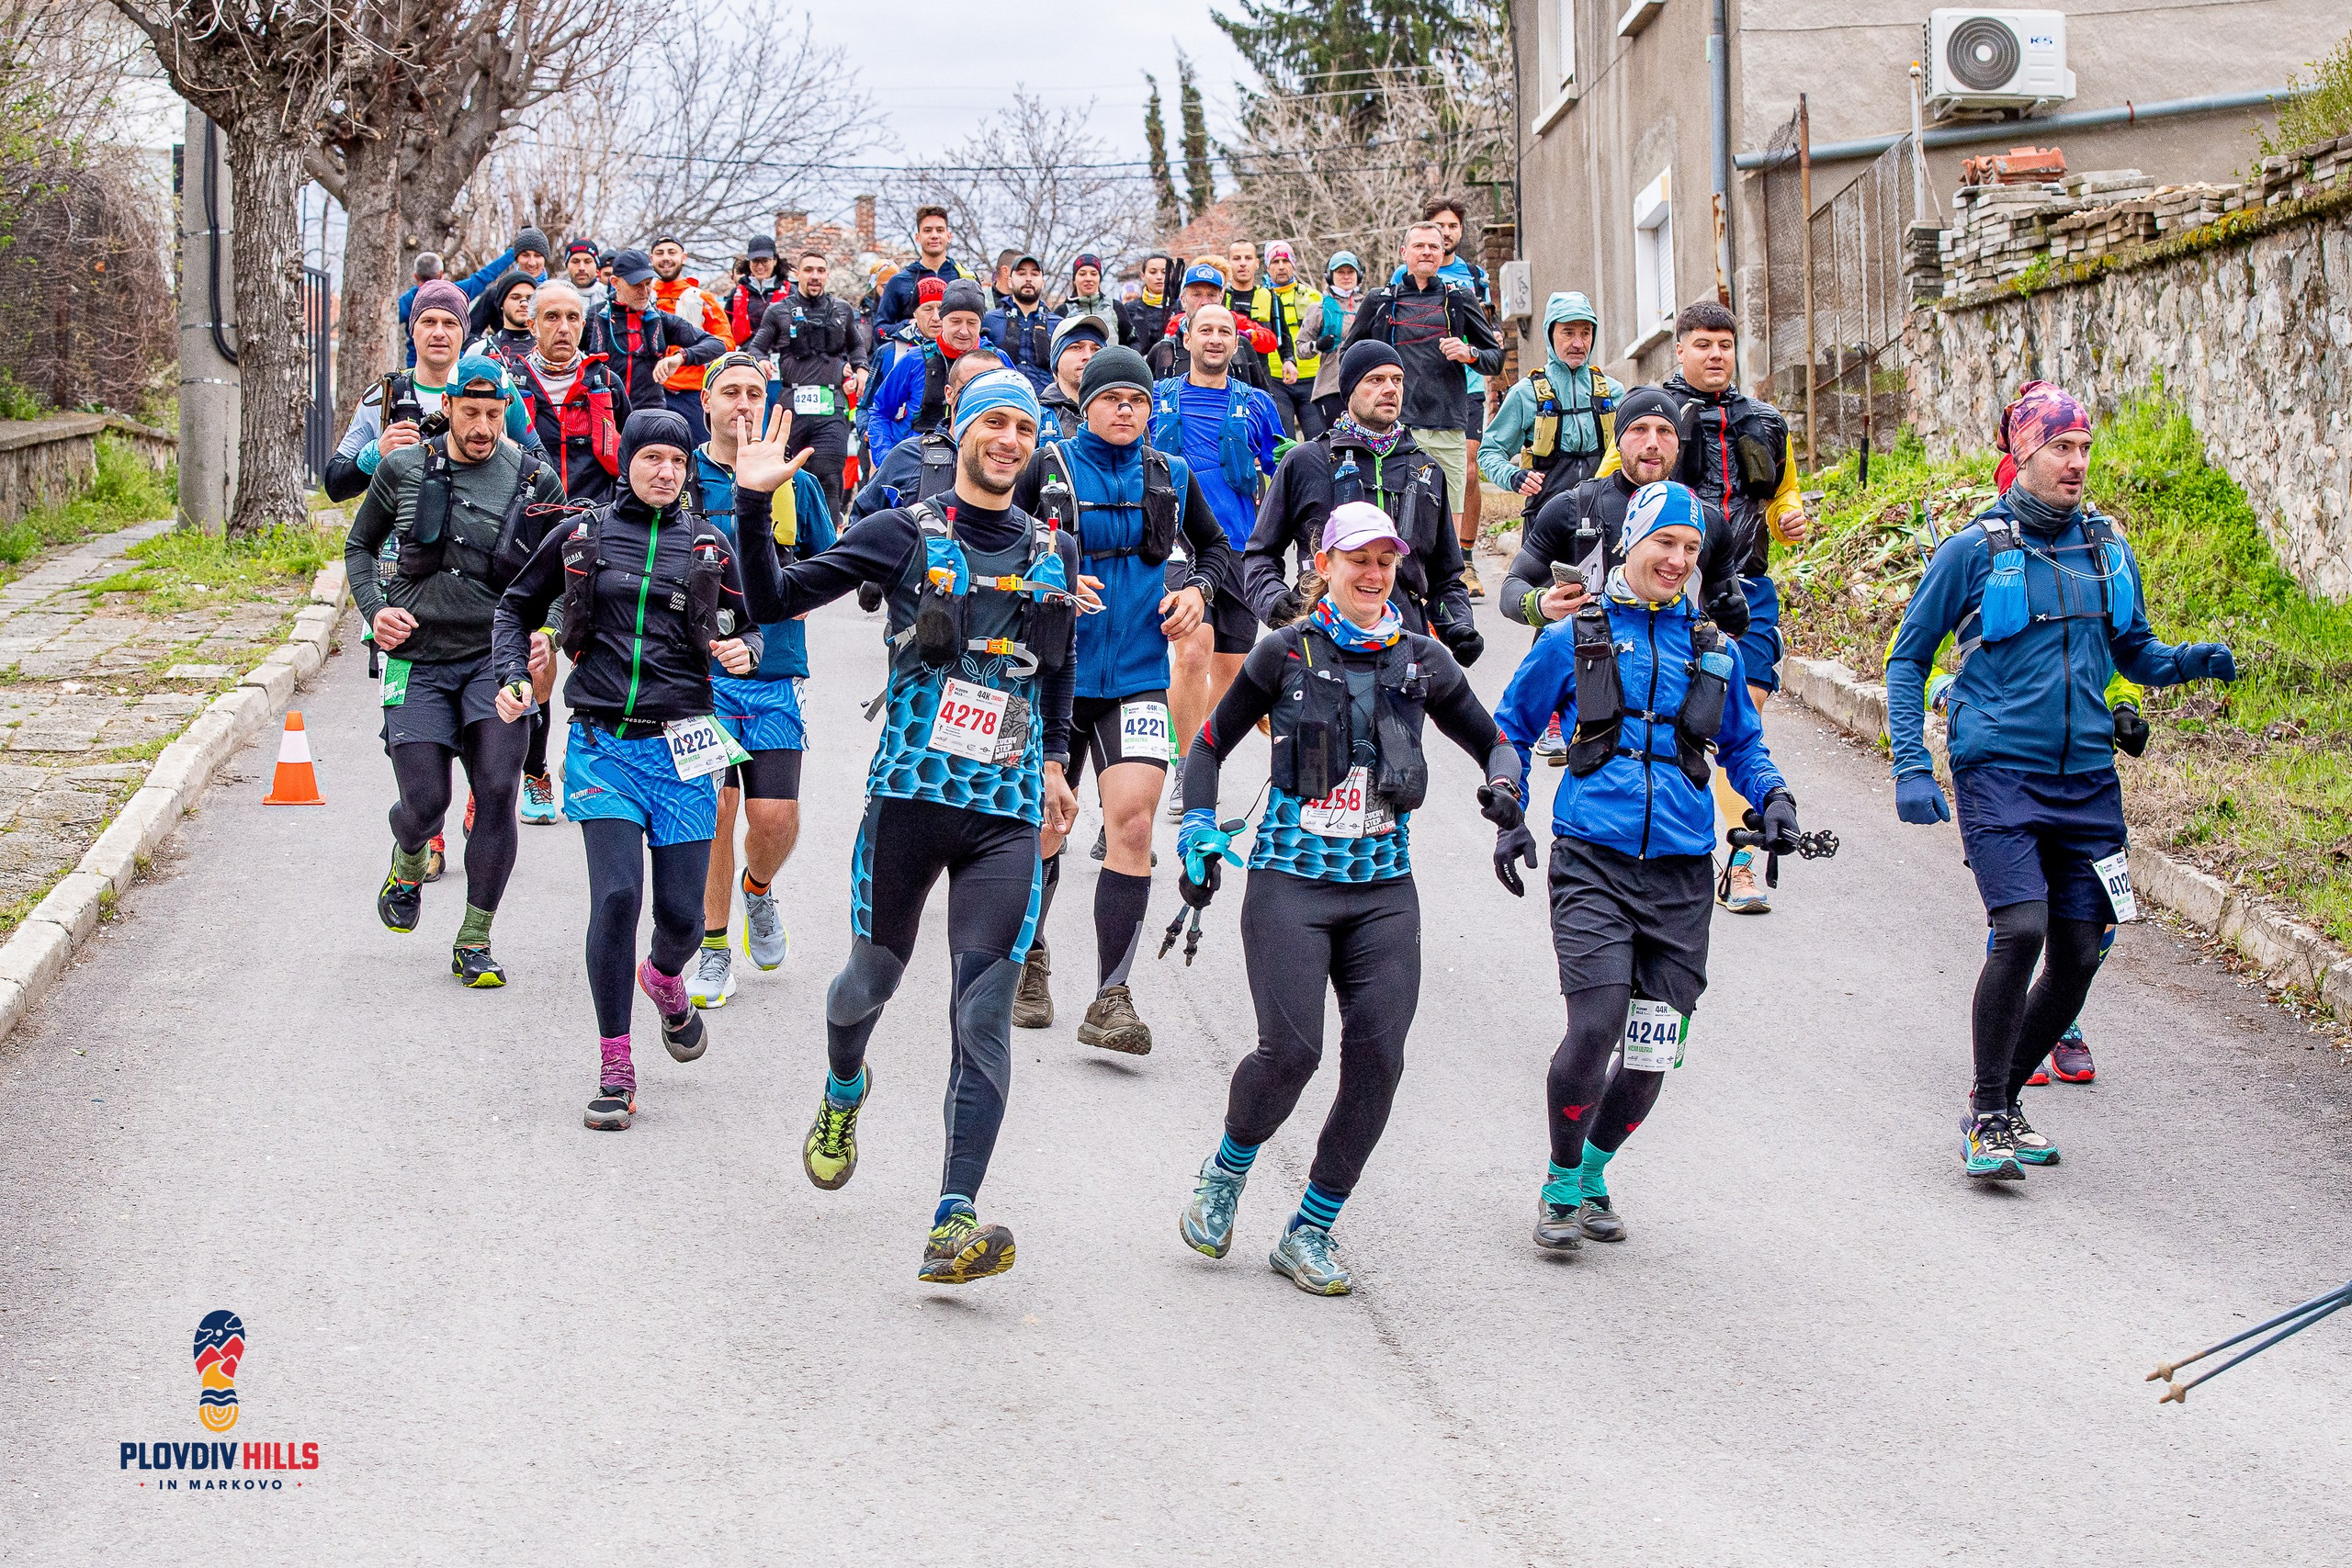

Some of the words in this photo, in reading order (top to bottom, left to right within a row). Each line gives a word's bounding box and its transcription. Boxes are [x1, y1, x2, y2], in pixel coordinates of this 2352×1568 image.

[795, 393, 819, 403] 4243
[939, 700, 997, 735] 4278
[1125, 717, 1165, 739] 4221
[673, 728, 718, 757] 4222
[2108, 870, 2133, 897] 412
[1655, 1005, 1668, 1014] 44K
[1626, 1020, 1678, 1045] 4244
